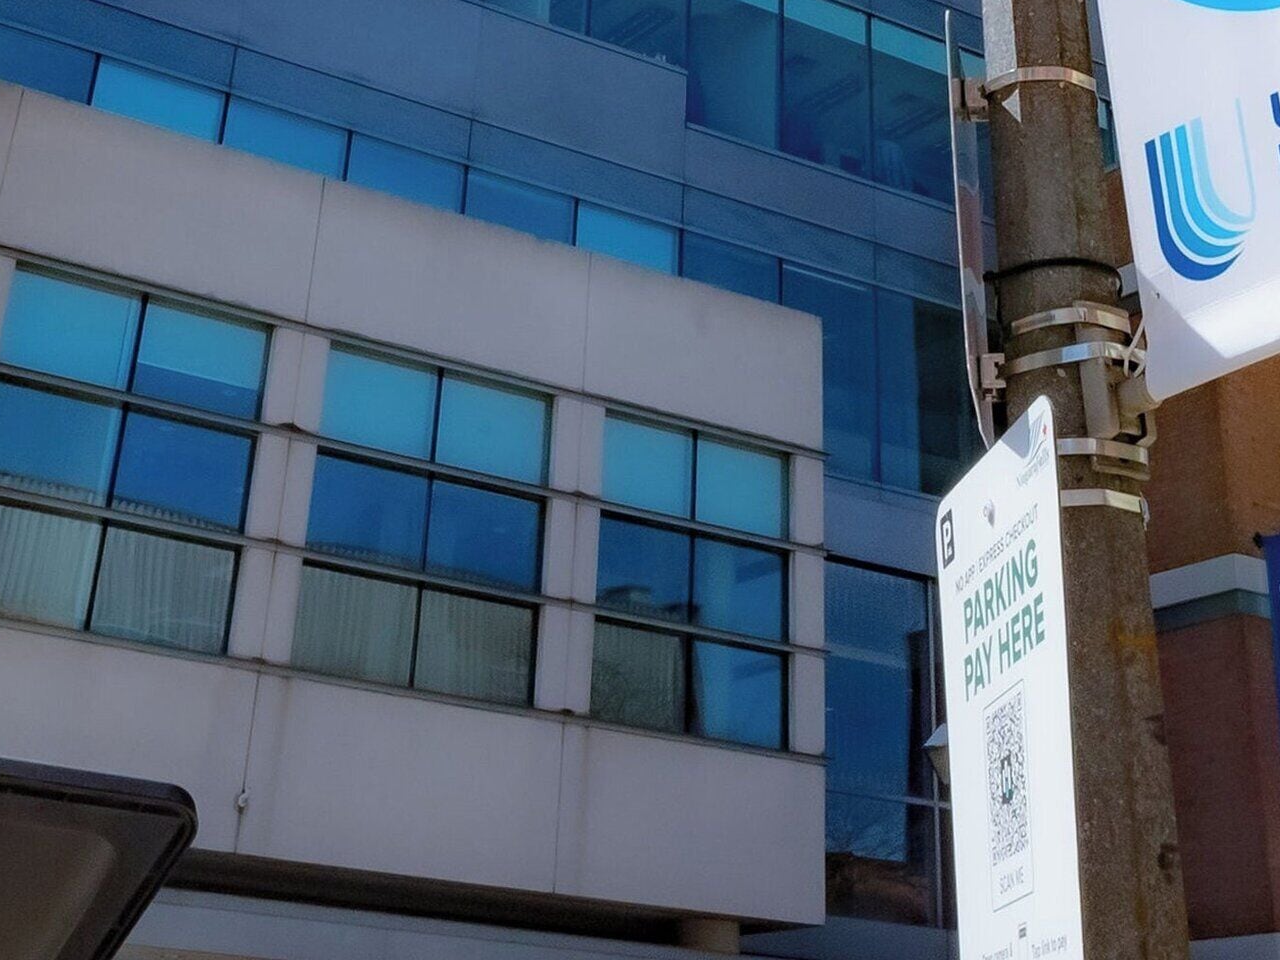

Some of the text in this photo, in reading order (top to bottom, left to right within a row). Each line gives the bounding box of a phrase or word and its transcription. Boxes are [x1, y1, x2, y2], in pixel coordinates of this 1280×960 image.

[979, 536, 1004, 573] EXPRESS
[1005, 502, 1038, 548] CHECKOUT
[963, 538, 1039, 644] PARKING
[963, 592, 1045, 702] PAY HERE
